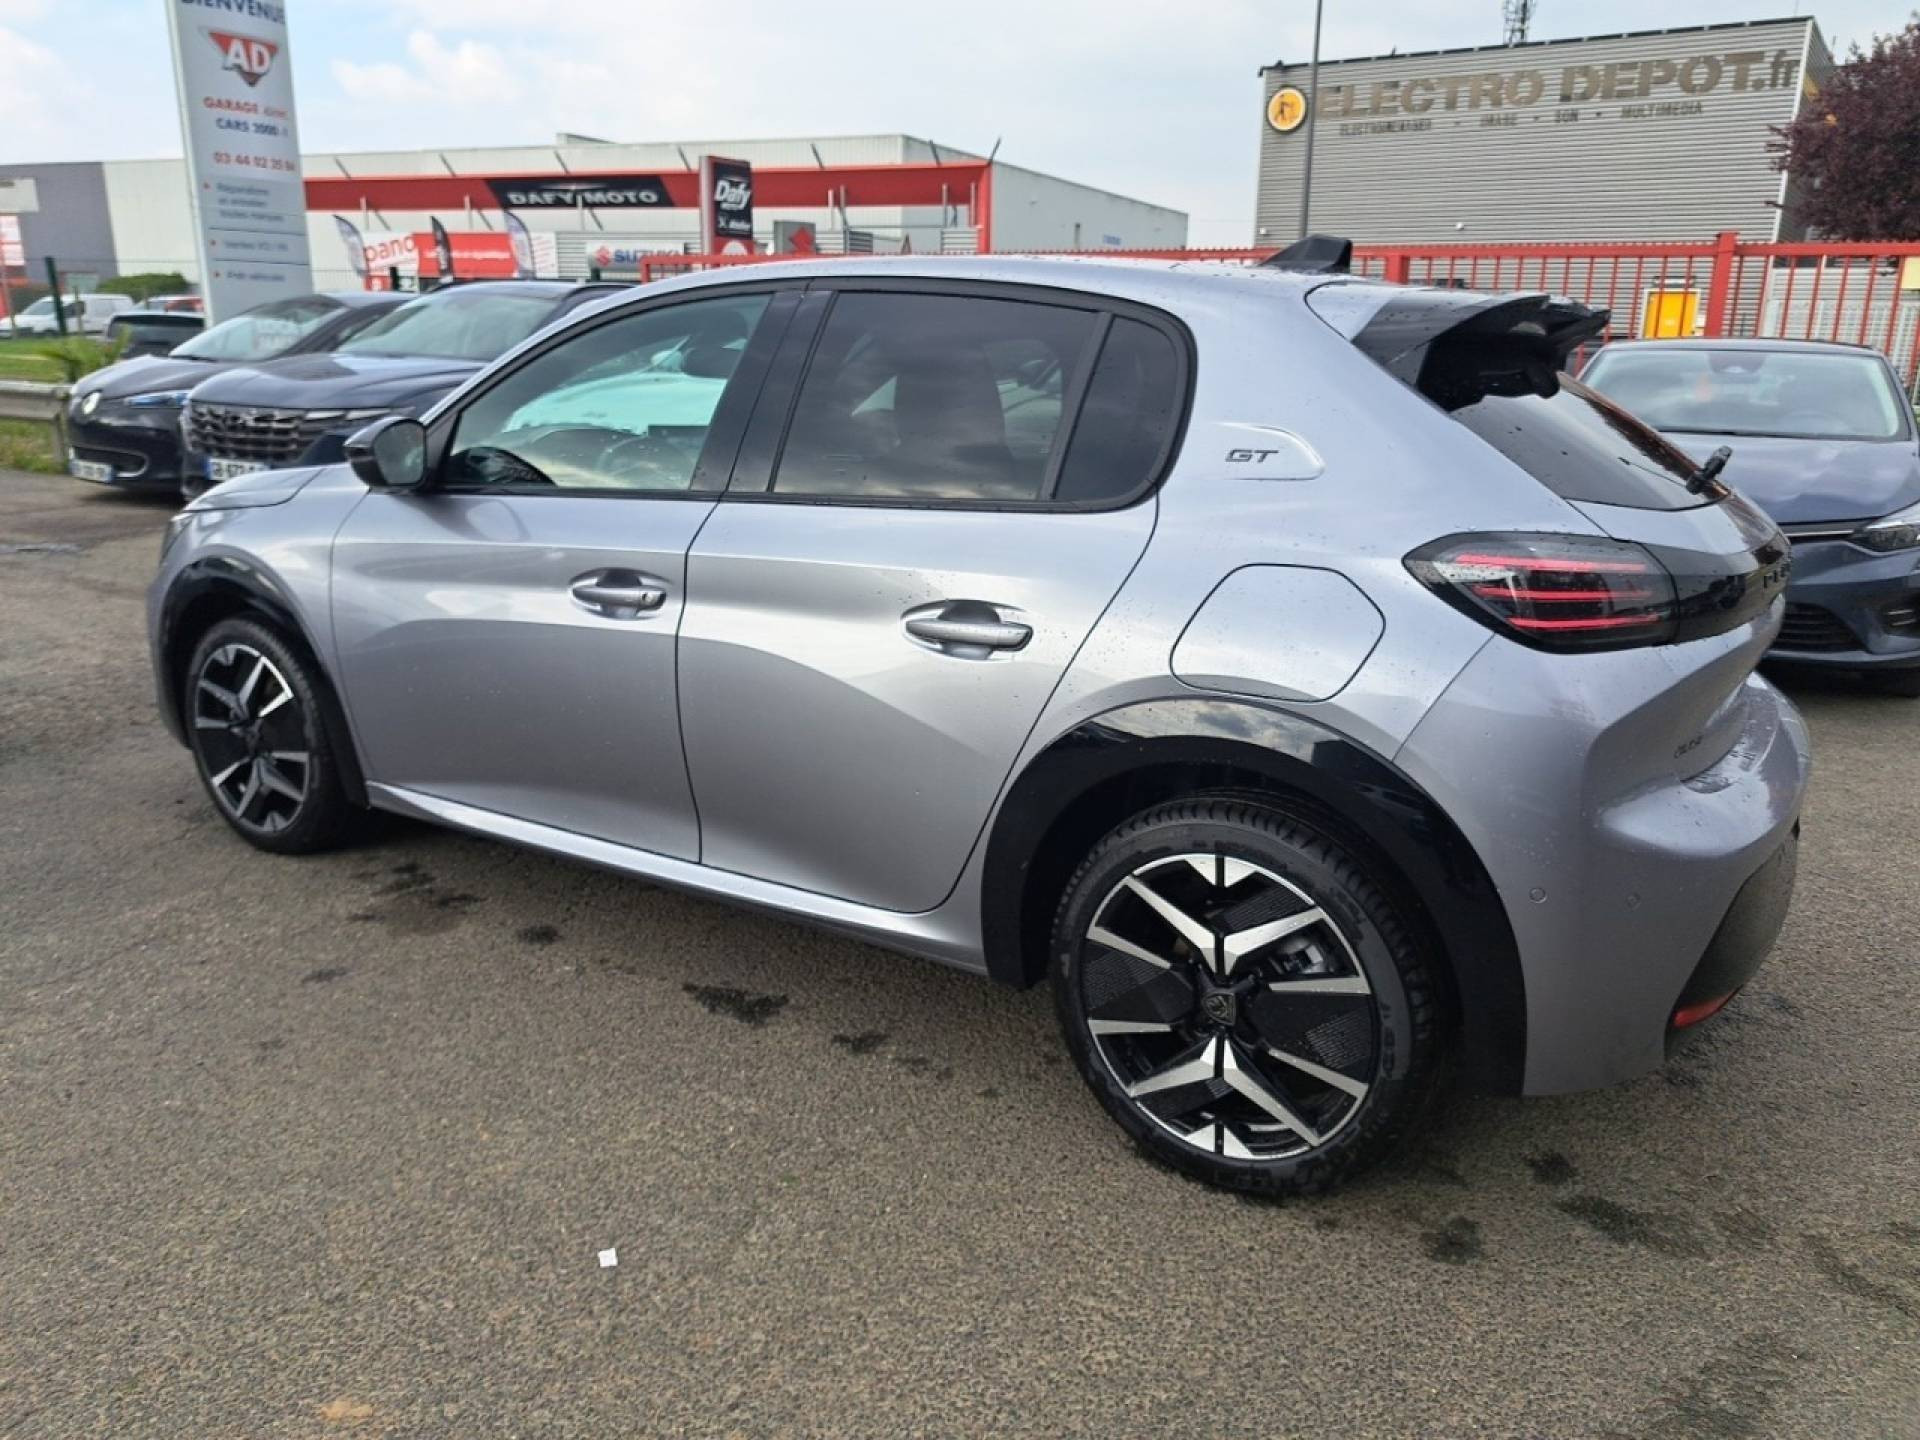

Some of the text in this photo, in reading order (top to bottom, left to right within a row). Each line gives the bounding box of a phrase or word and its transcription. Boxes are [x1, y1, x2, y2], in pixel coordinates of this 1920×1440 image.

[221, 38, 272, 74] AD
[1316, 69, 1545, 119] ELECTRO
[506, 189, 660, 205] DAFY MOTO
[714, 179, 751, 210] Dafy
[1225, 448, 1279, 463] GT
